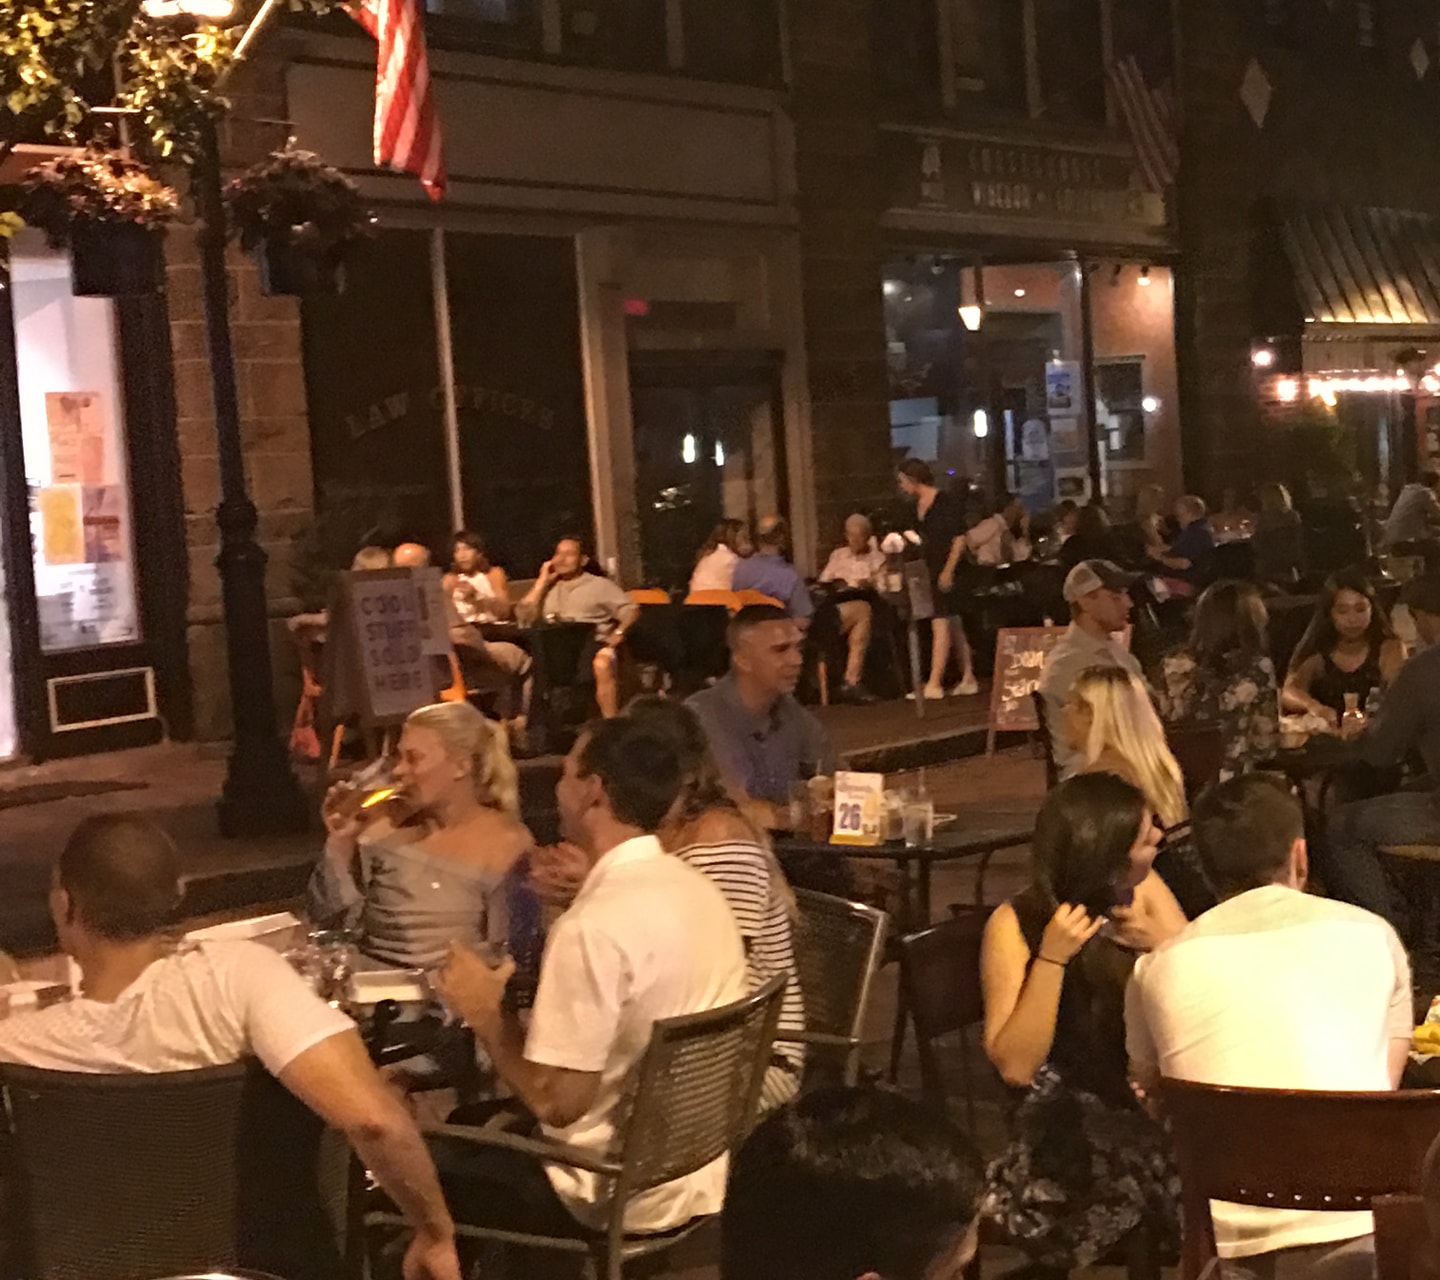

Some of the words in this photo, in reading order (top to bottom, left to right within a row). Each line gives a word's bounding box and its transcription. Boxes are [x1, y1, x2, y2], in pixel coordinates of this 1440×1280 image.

[344, 390, 410, 440] LAW
[361, 594, 416, 616] COOL
[370, 645, 421, 667] SOLD
[375, 670, 424, 692] HERE
[838, 802, 862, 831] 26
